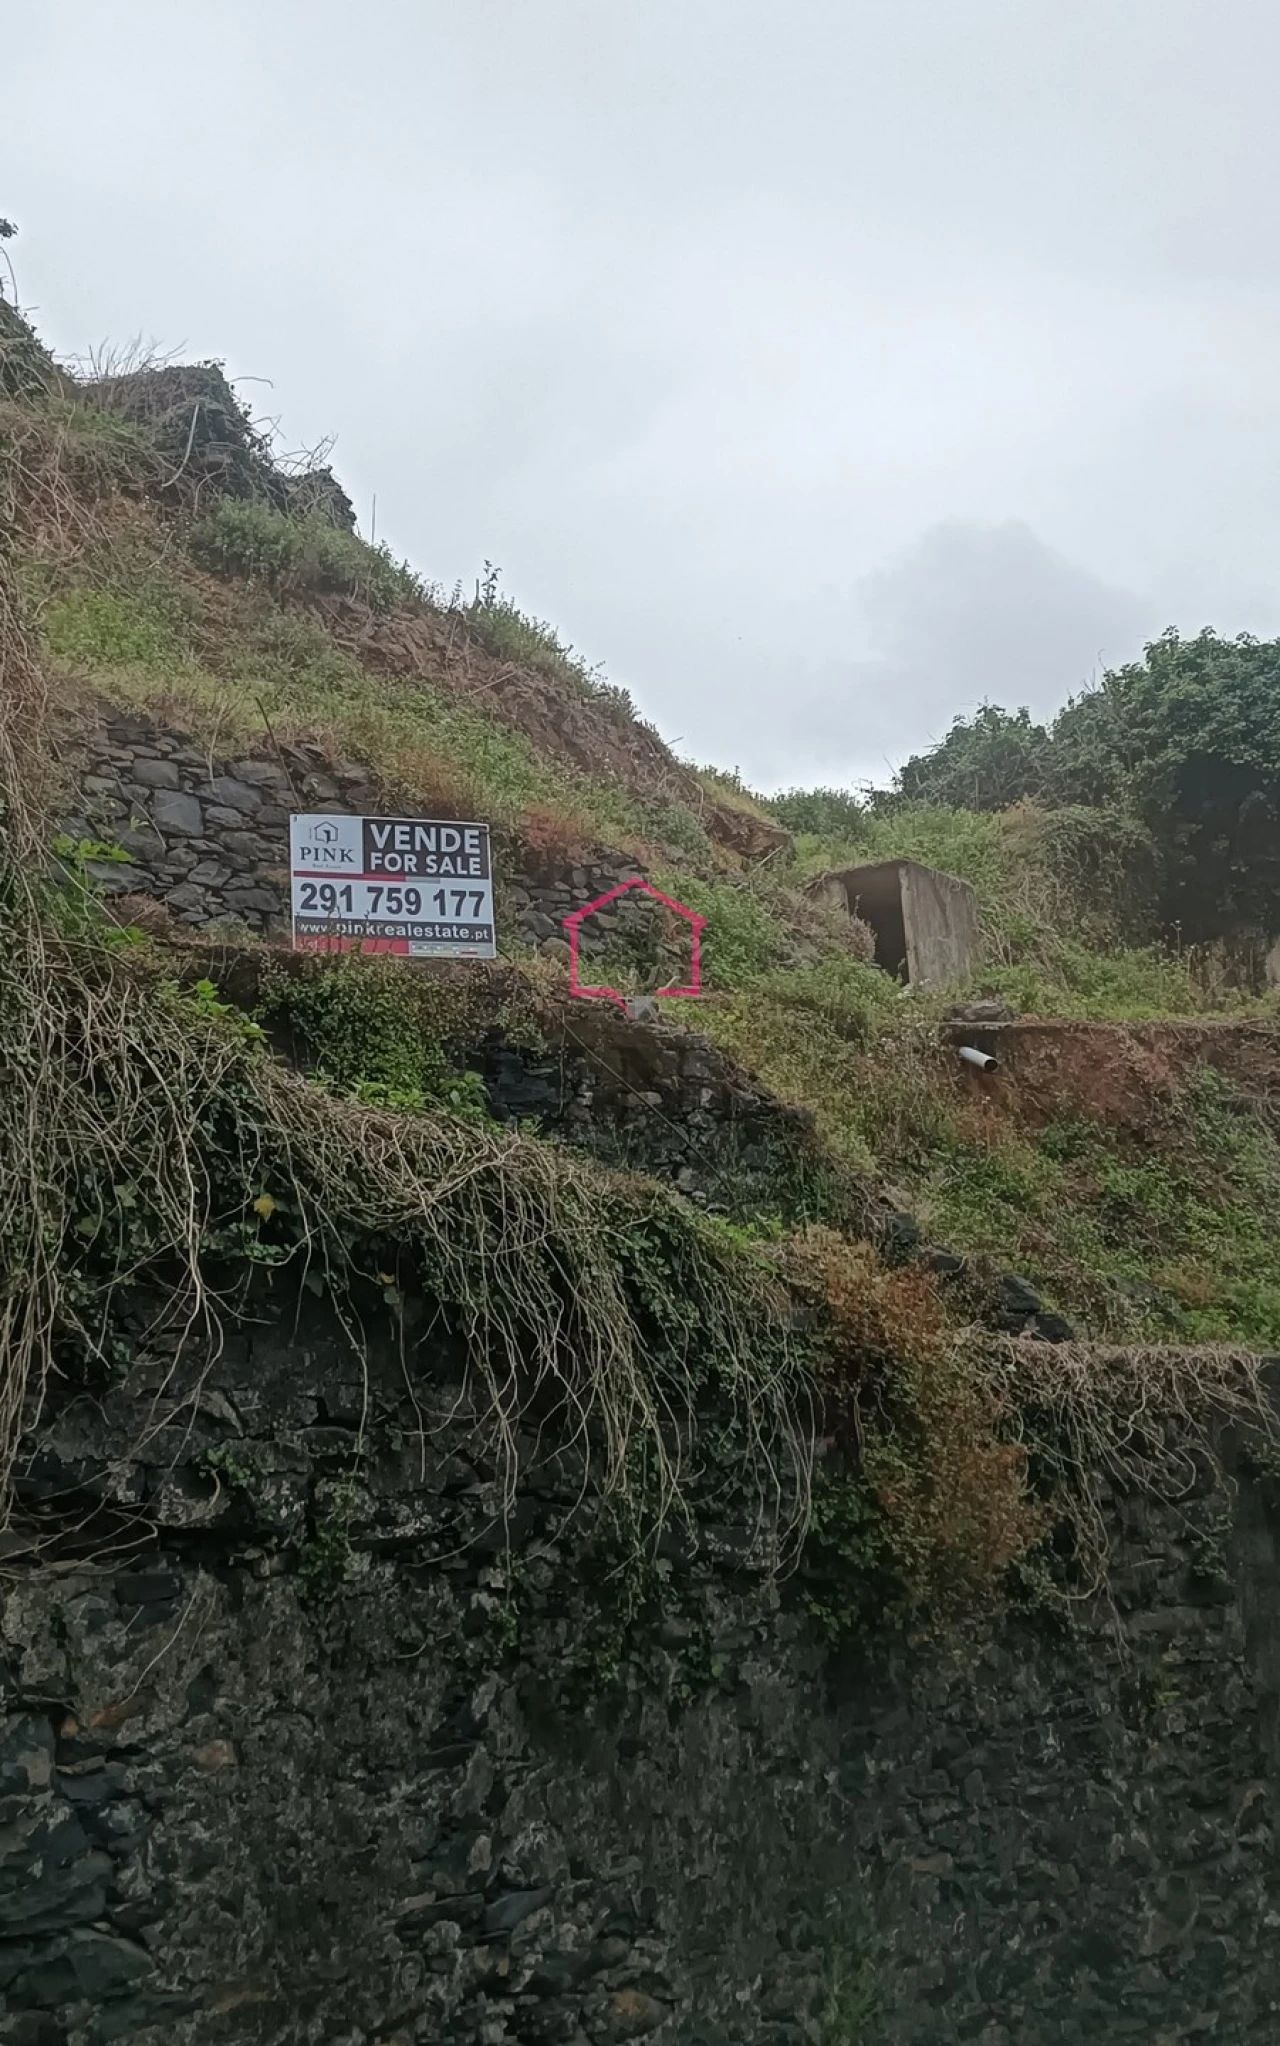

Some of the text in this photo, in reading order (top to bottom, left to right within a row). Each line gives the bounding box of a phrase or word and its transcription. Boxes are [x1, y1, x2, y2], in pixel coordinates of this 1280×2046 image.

[370, 824, 480, 855] VENDE
[300, 846, 355, 863] PINK
[370, 852, 481, 875] FOR SALE
[300, 883, 485, 917] 291 759 177
[296, 922, 489, 940] wwwpinkrealestate.pt
